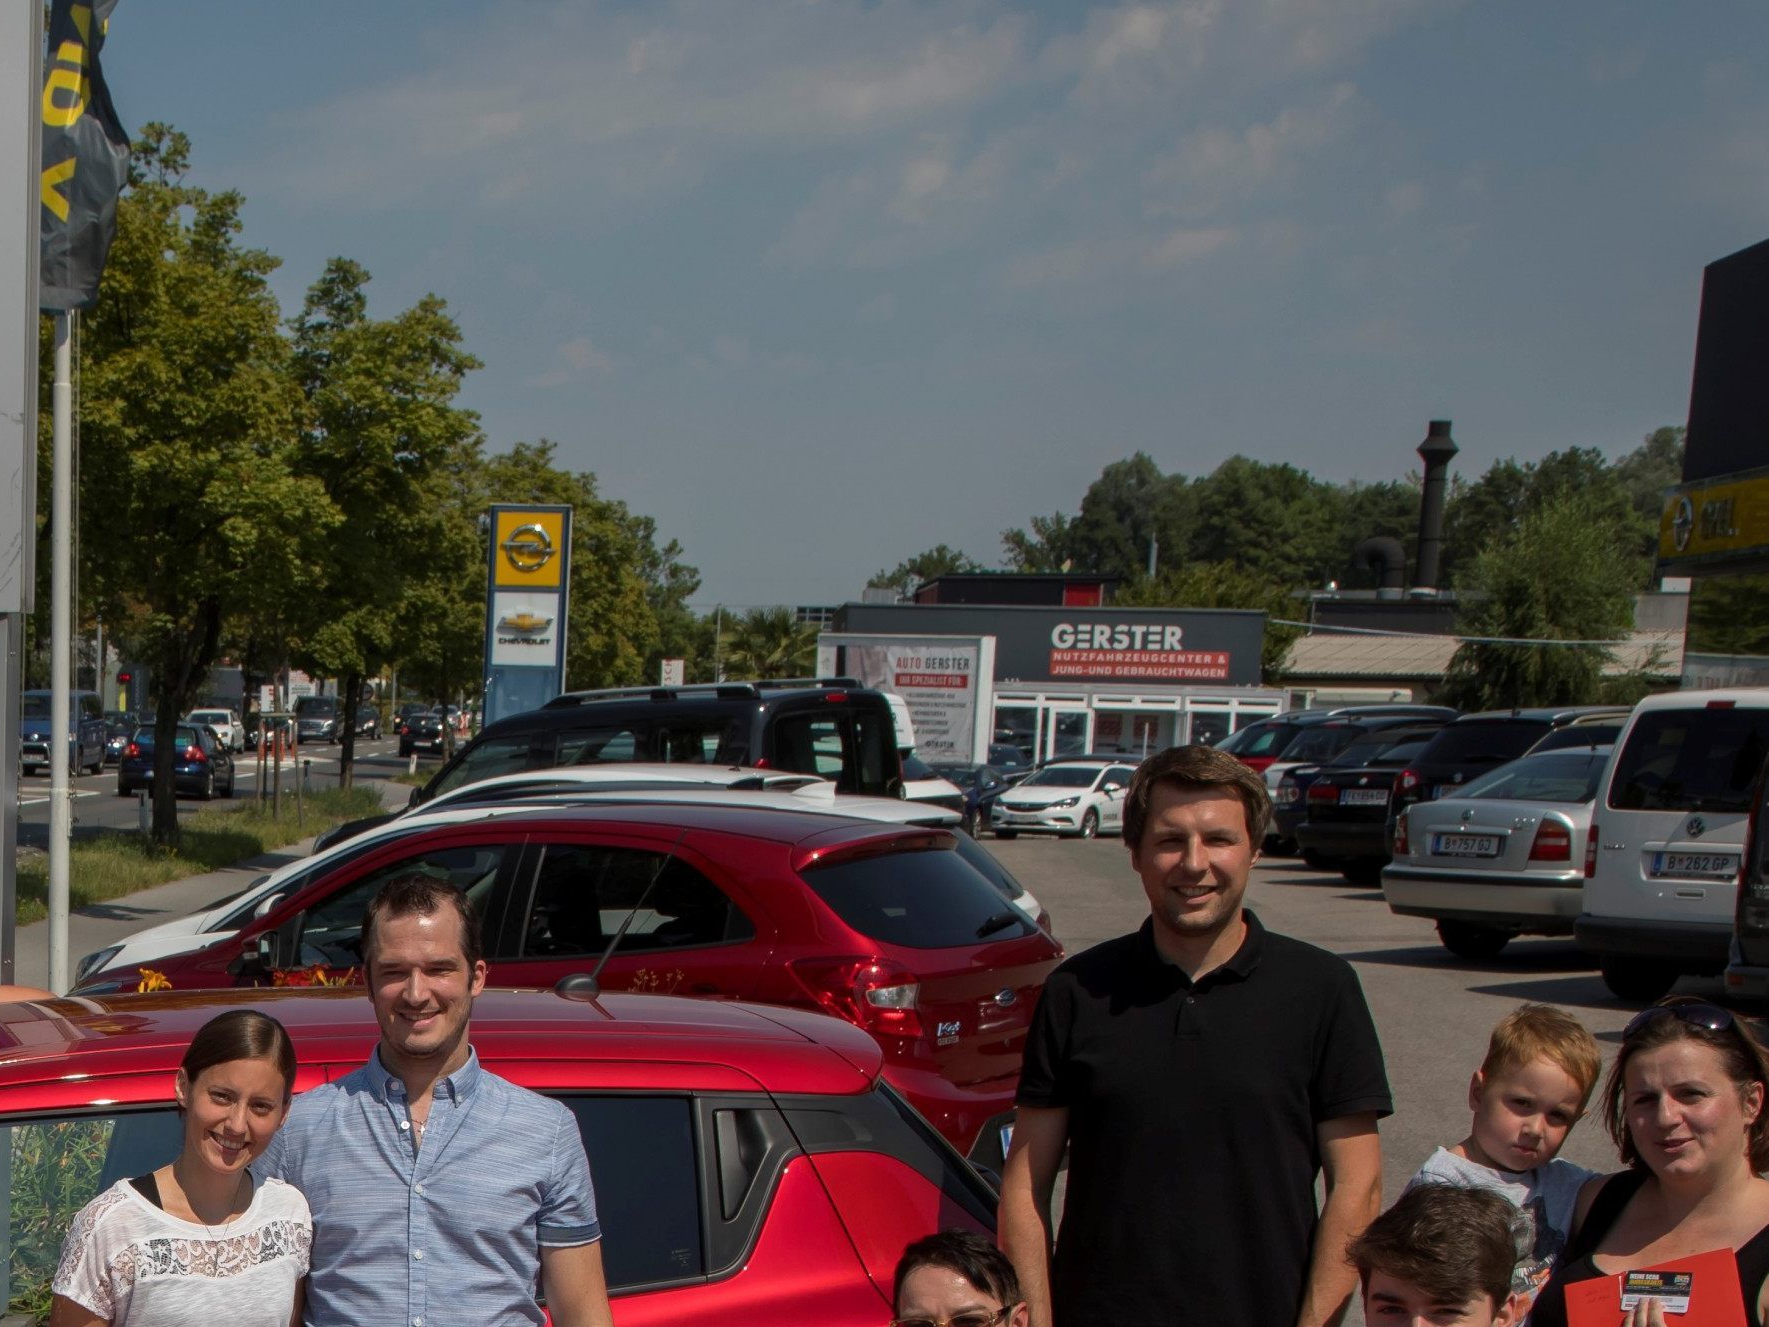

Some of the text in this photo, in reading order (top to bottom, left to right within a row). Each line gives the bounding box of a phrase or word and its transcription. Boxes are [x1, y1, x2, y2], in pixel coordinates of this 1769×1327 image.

[498, 637, 551, 645] CHEVROLET
[1051, 624, 1182, 650] GERSTER
[896, 656, 970, 670] AUTO GERSTER
[1052, 652, 1226, 665] NUTZFAHRZEUGCENTER &
[1052, 665, 1226, 679] JUNG-UND GEBRAUCHTWAGEN
[1458, 837, 1477, 850] 757
[1667, 856, 1730, 872] B 262 GP
